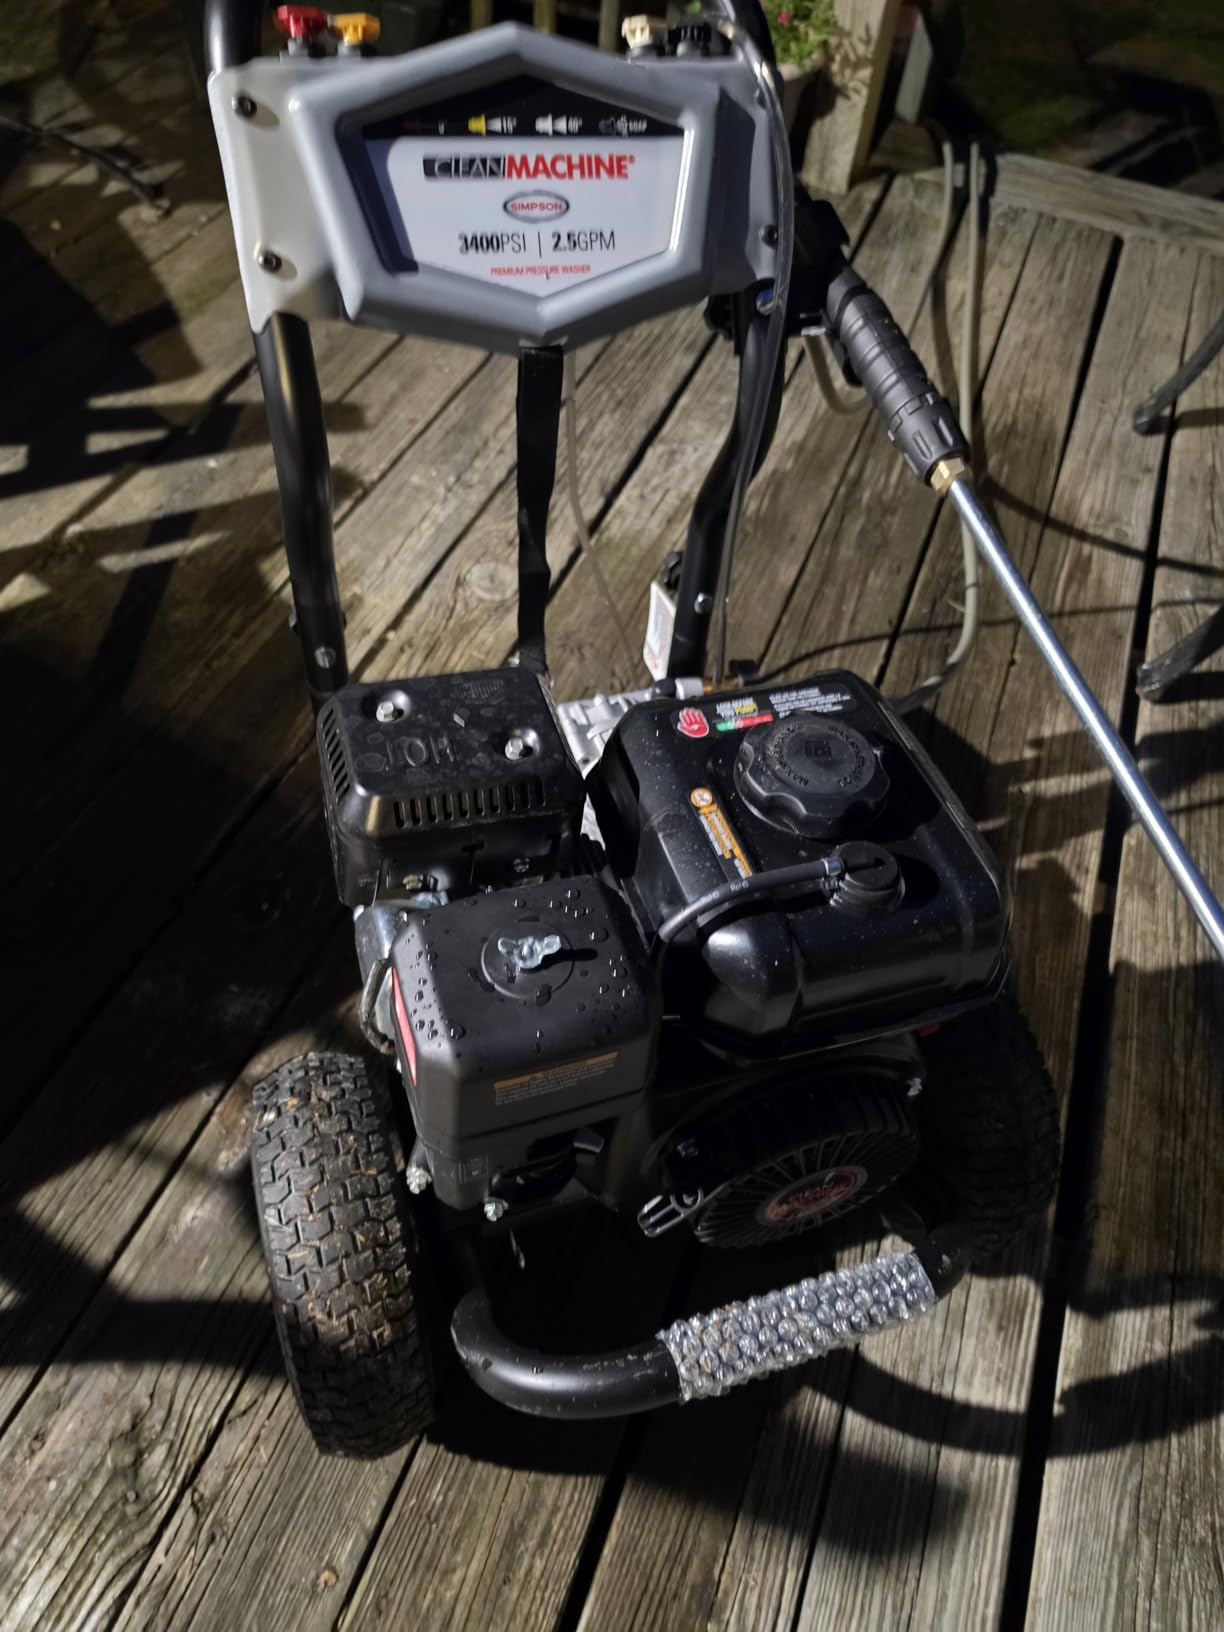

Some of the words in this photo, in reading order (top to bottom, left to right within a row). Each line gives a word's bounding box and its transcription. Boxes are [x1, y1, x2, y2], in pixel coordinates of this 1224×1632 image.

[511, 202, 562, 212] SIMPSON
[458, 231, 527, 255] 3400PSI
[552, 230, 616, 252] 2.5GPM
[490, 266, 524, 277] PREMIUM
[526, 265, 559, 275] PRESSURE
[561, 264, 591, 274] WASHER
